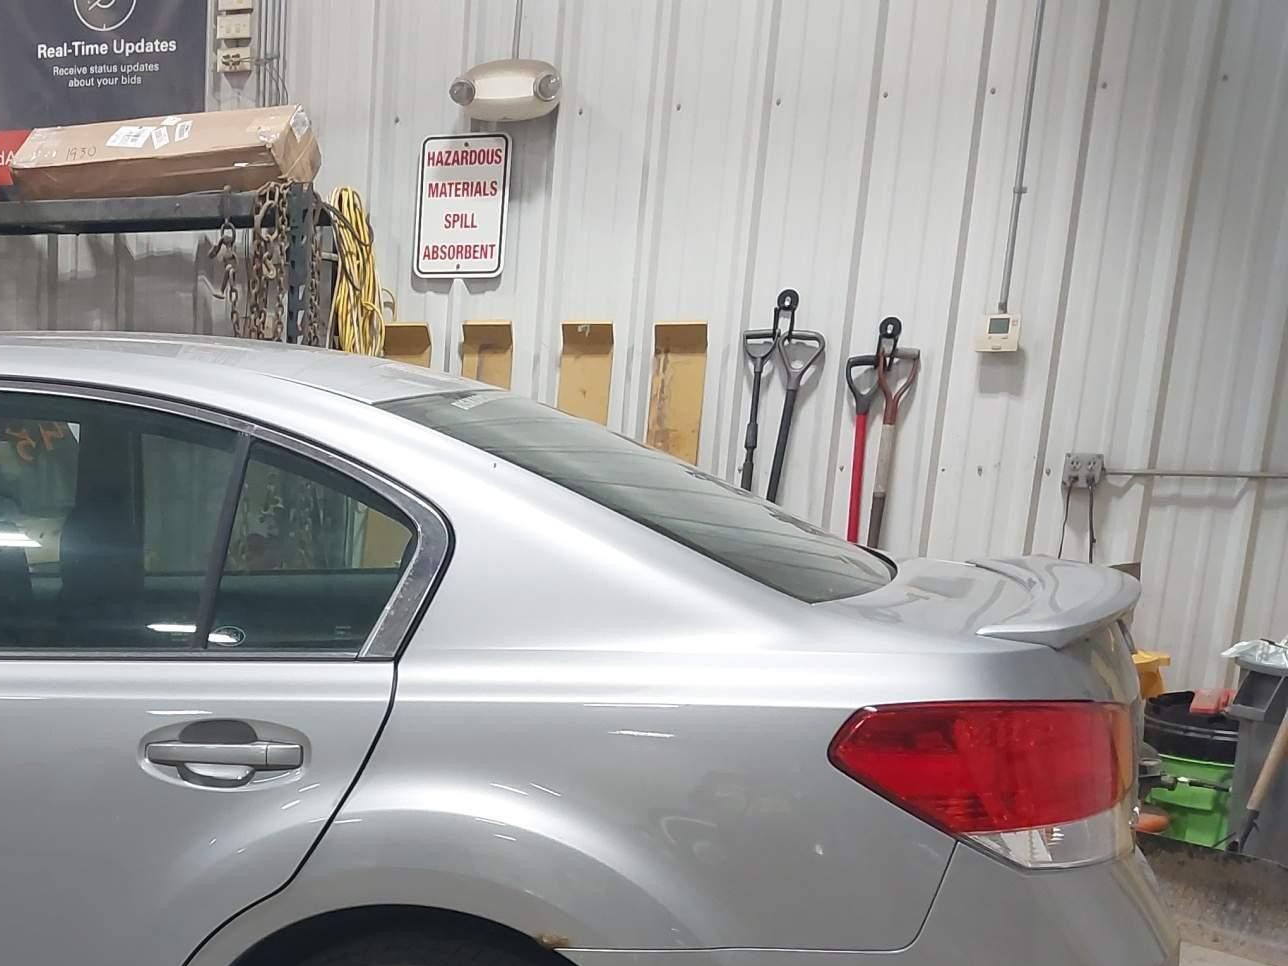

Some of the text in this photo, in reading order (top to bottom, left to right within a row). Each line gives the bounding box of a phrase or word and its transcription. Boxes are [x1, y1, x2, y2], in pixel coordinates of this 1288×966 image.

[37, 38, 177, 59] Real-Time Updates
[53, 62, 160, 76] Receive status updates
[68, 75, 142, 88] about your bids
[427, 148, 502, 167] HAZARDOUS
[427, 180, 498, 198] MATERIALS
[444, 212, 478, 229] SPILL
[423, 243, 496, 261] ABSORBENT
